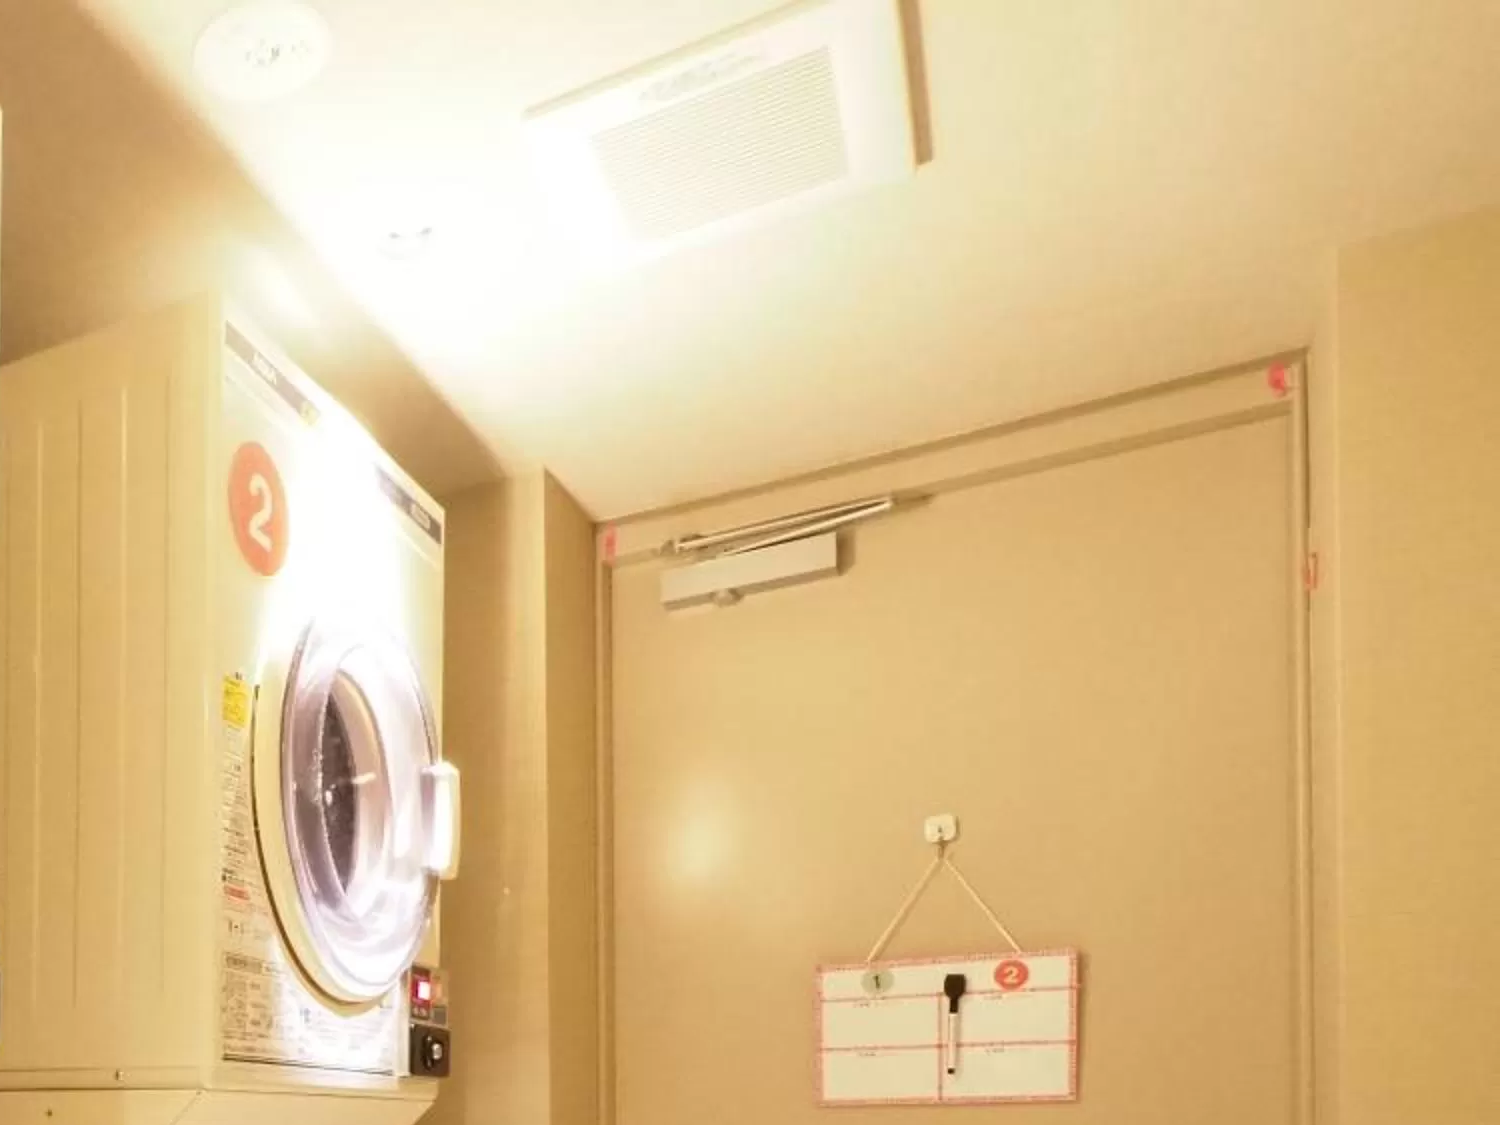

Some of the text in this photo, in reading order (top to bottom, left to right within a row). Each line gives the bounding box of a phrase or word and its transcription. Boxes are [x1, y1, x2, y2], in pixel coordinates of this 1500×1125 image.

[248, 473, 273, 553] 2
[872, 975, 881, 989] 1
[1005, 969, 1020, 983] 2
